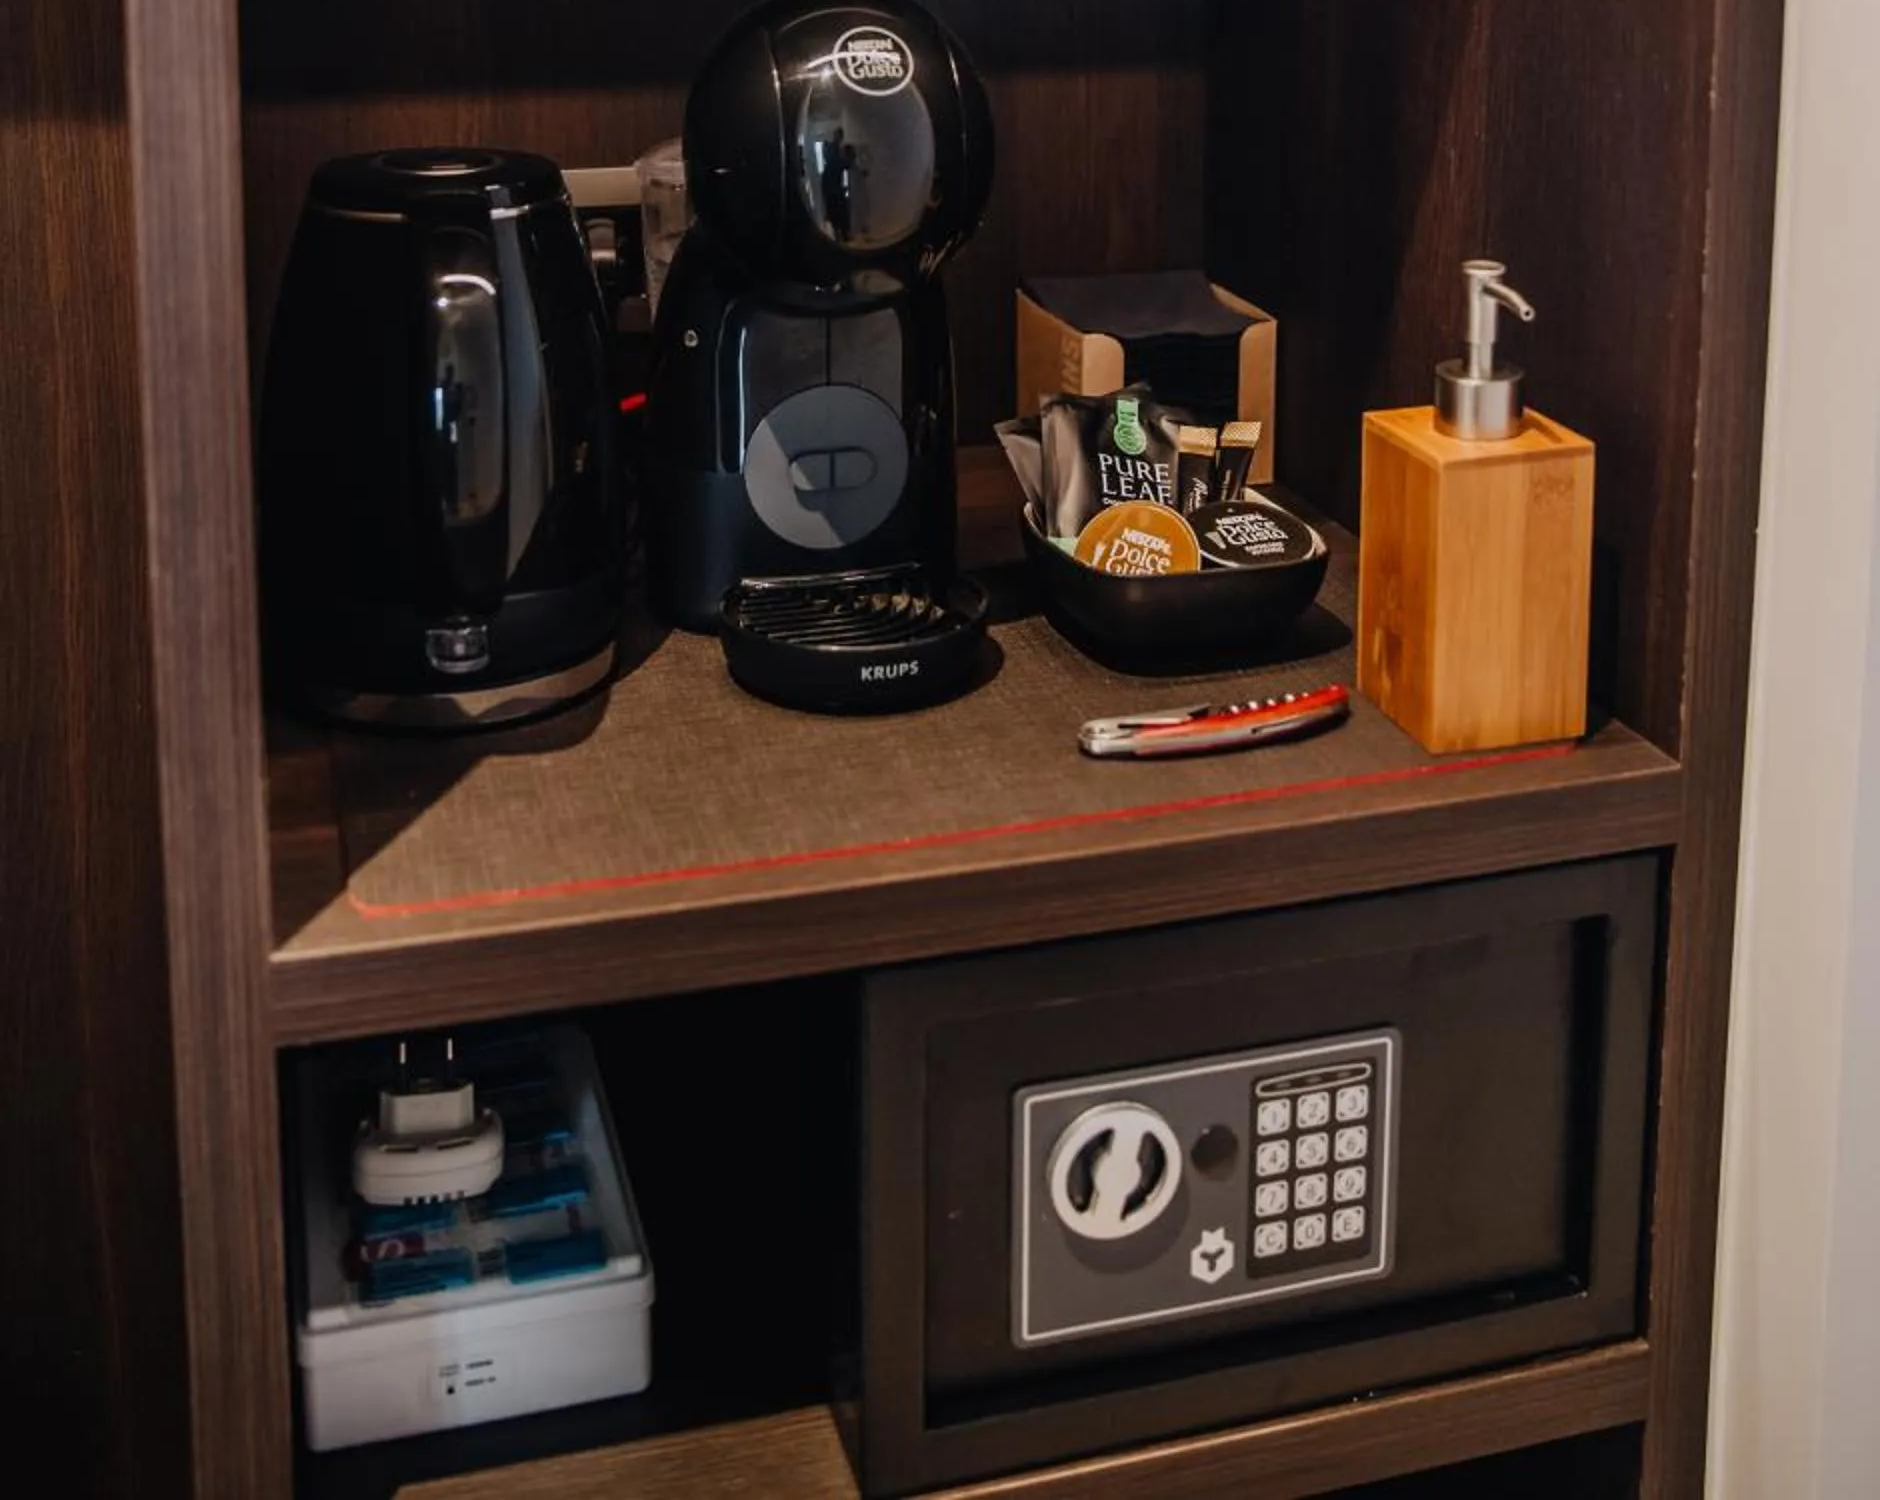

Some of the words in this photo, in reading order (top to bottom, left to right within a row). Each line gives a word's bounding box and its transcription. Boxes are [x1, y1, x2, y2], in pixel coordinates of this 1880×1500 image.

[849, 63, 904, 80] Gusto
[1098, 453, 1170, 483] PURE
[1102, 474, 1172, 504] LEAF
[1111, 538, 1171, 574] Dolce
[861, 660, 919, 681] KRUPS
